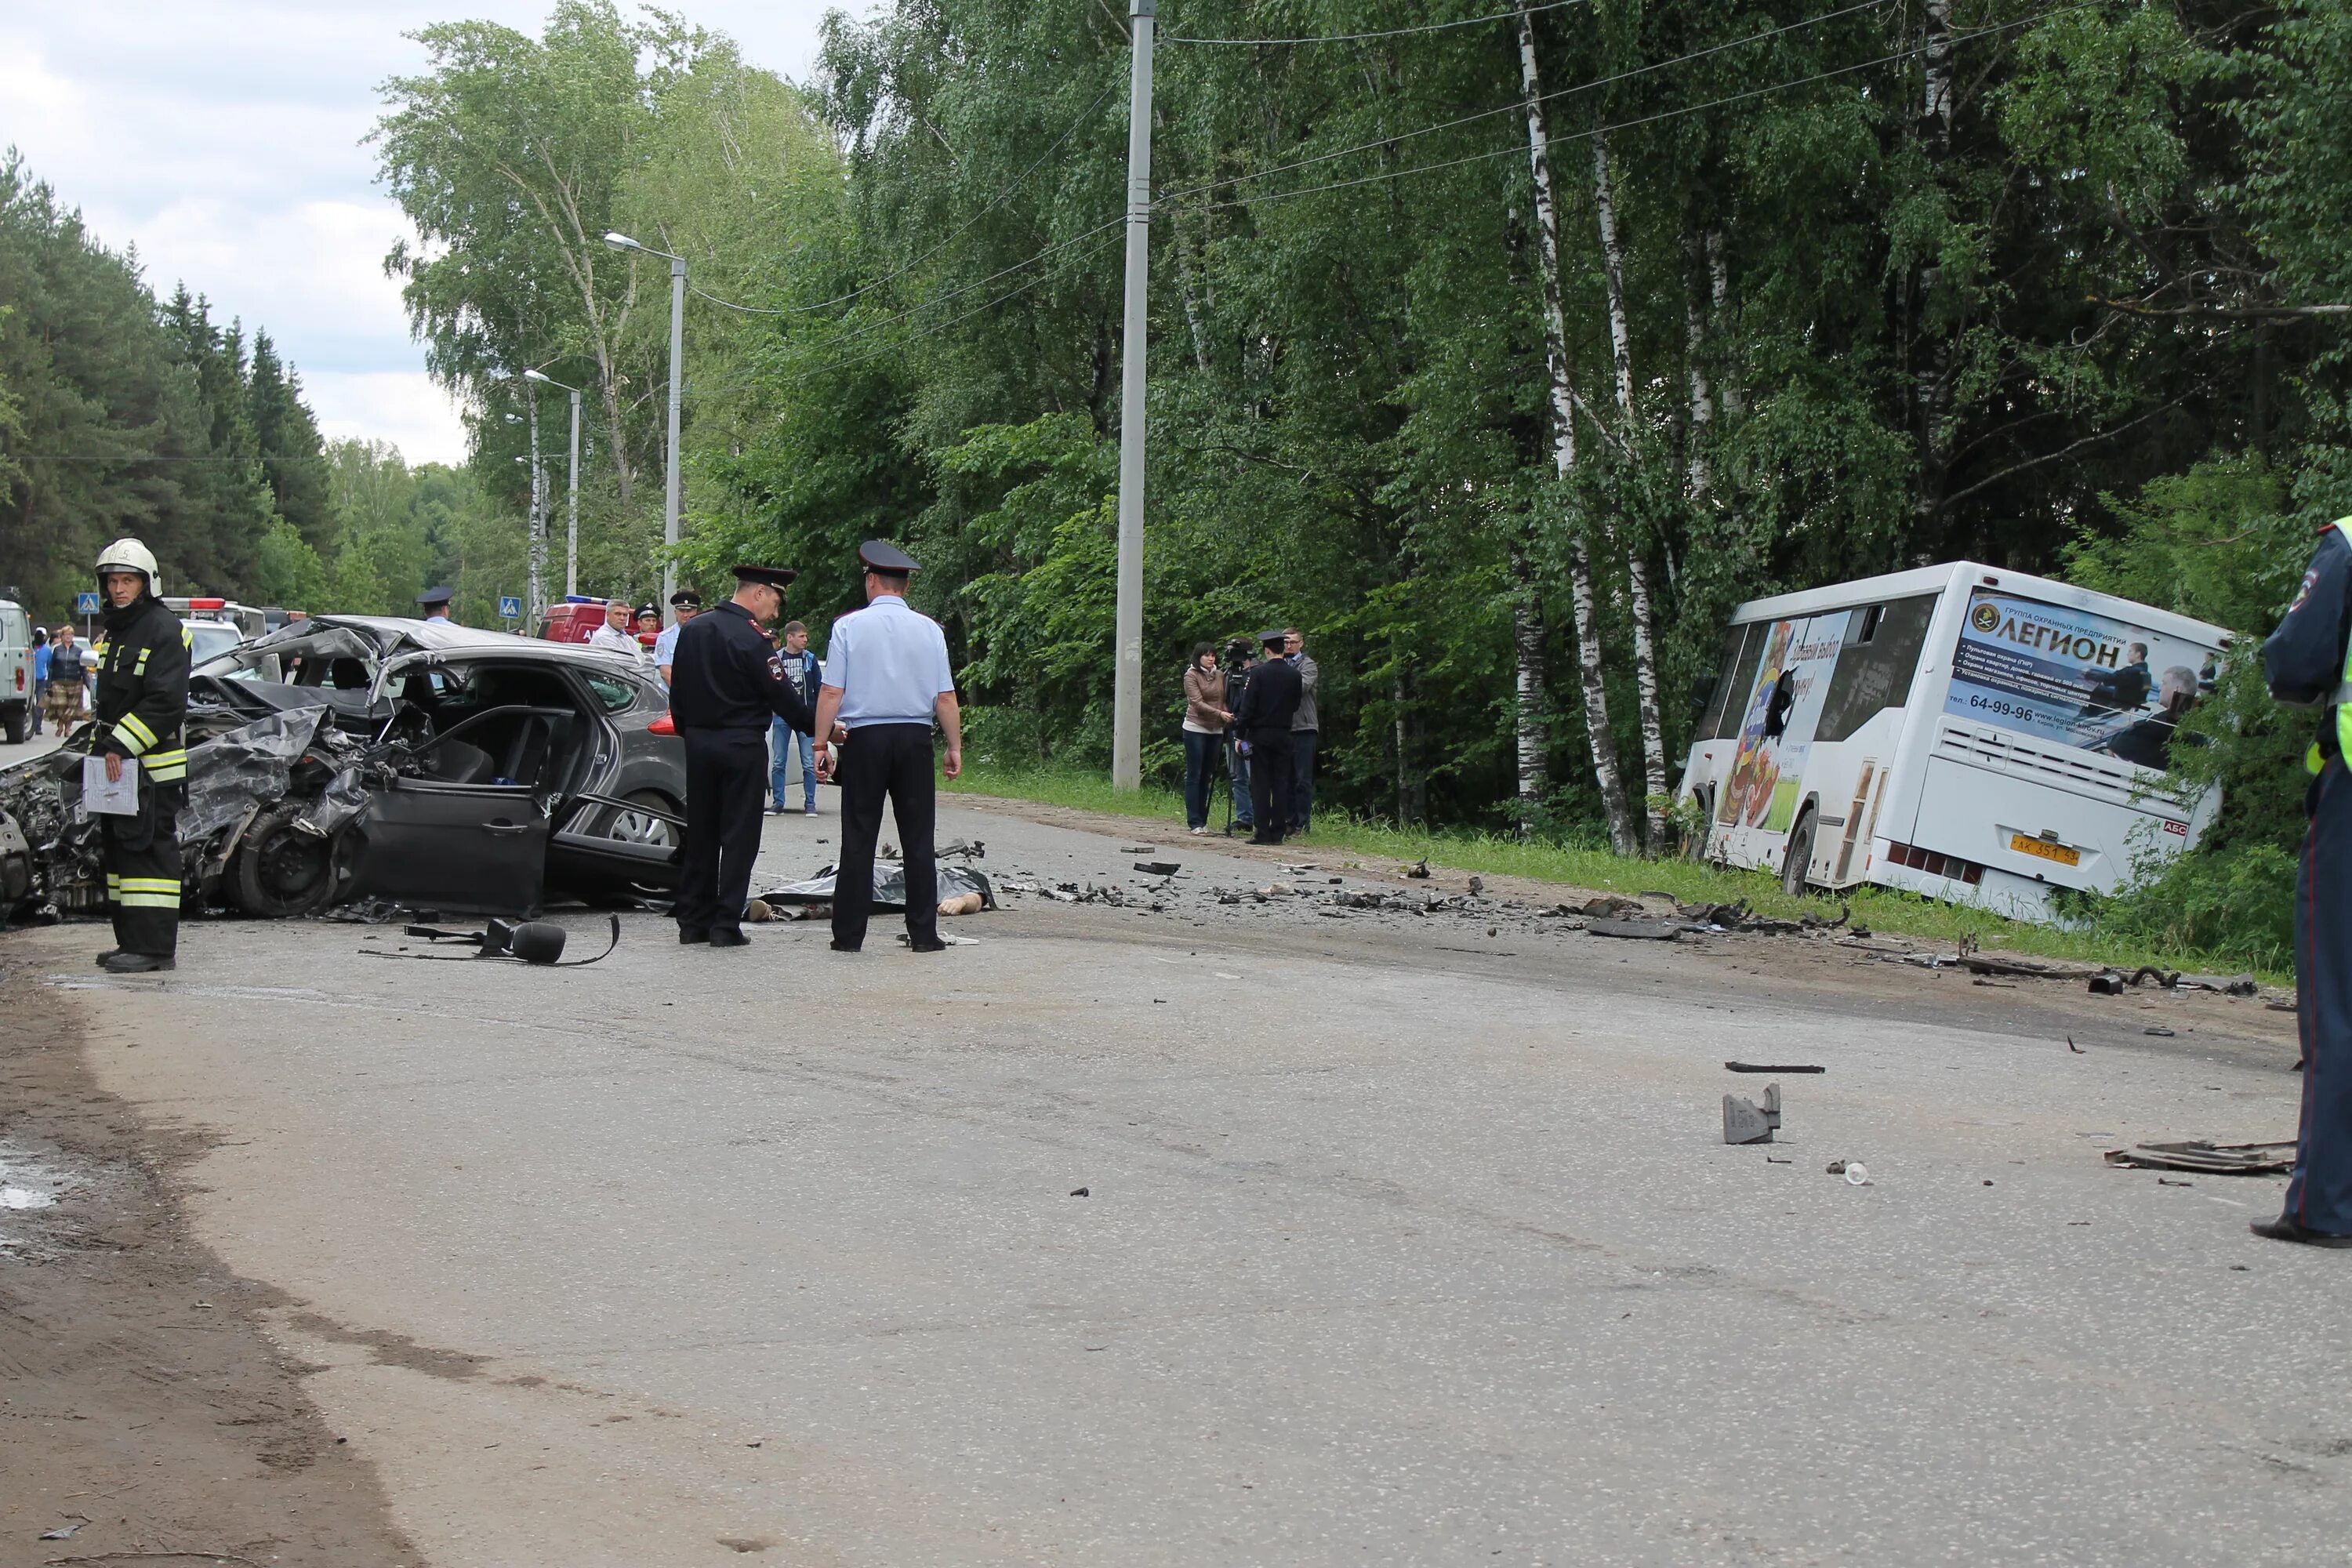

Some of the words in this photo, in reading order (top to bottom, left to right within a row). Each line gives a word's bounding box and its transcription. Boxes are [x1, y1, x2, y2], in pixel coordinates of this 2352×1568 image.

[2005, 607, 2032, 619] ГРУППА
[2034, 615, 2074, 630] ОХРАННЫХ
[2074, 626, 2127, 645] ПРЕДПРИЯТИЙ
[1996, 617, 2120, 669] ЛЕГИОН
[1965, 652, 1986, 662] Охрана
[1966, 644, 1997, 658] Пультовая
[1997, 654, 2017, 664] охрана
[1962, 659, 1984, 670] Охрана
[1962, 669, 1990, 681] Установка
[1950, 695, 1967, 705] тел.:
[1970, 695, 2034, 721] 64-99-96
[2034, 711, 2105, 735] www.legion-kirov.ru
[2164, 823, 2187, 834] АБС
[2035, 844, 2058, 859] 351
[2063, 851, 2076, 860] 43
